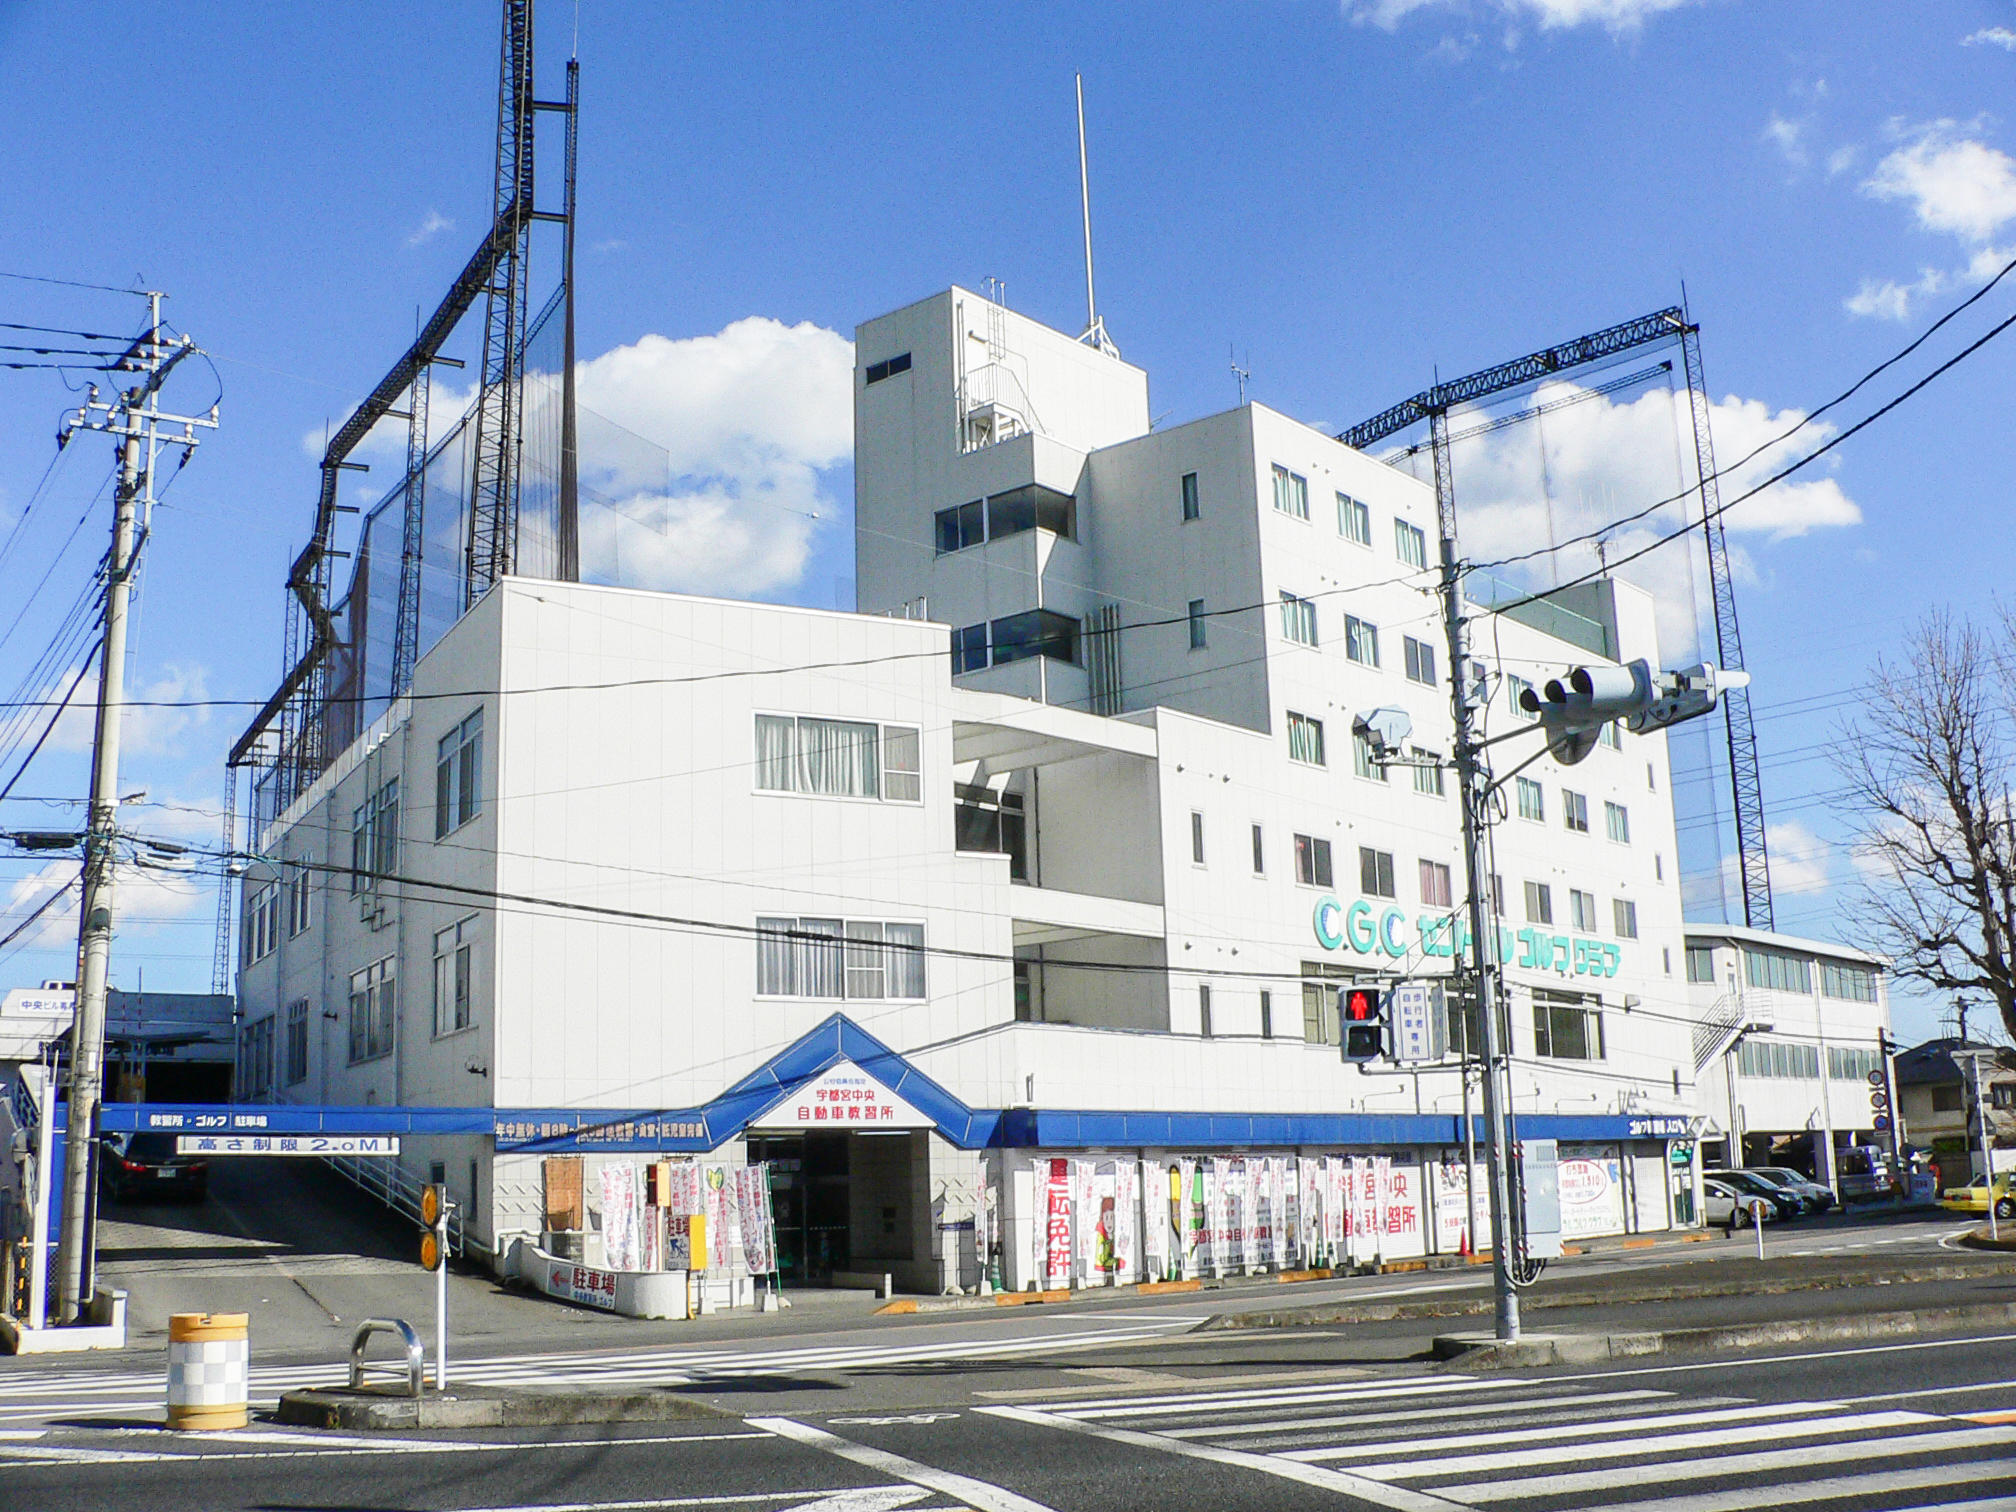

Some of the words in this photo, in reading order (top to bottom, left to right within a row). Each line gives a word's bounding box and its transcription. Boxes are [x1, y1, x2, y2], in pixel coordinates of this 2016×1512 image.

[816, 1088, 875, 1102] 宇都宮中央
[797, 1105, 894, 1121] 自動車教習所
[234, 1114, 268, 1128] 駐車場
[572, 1267, 616, 1296] 駐車場
